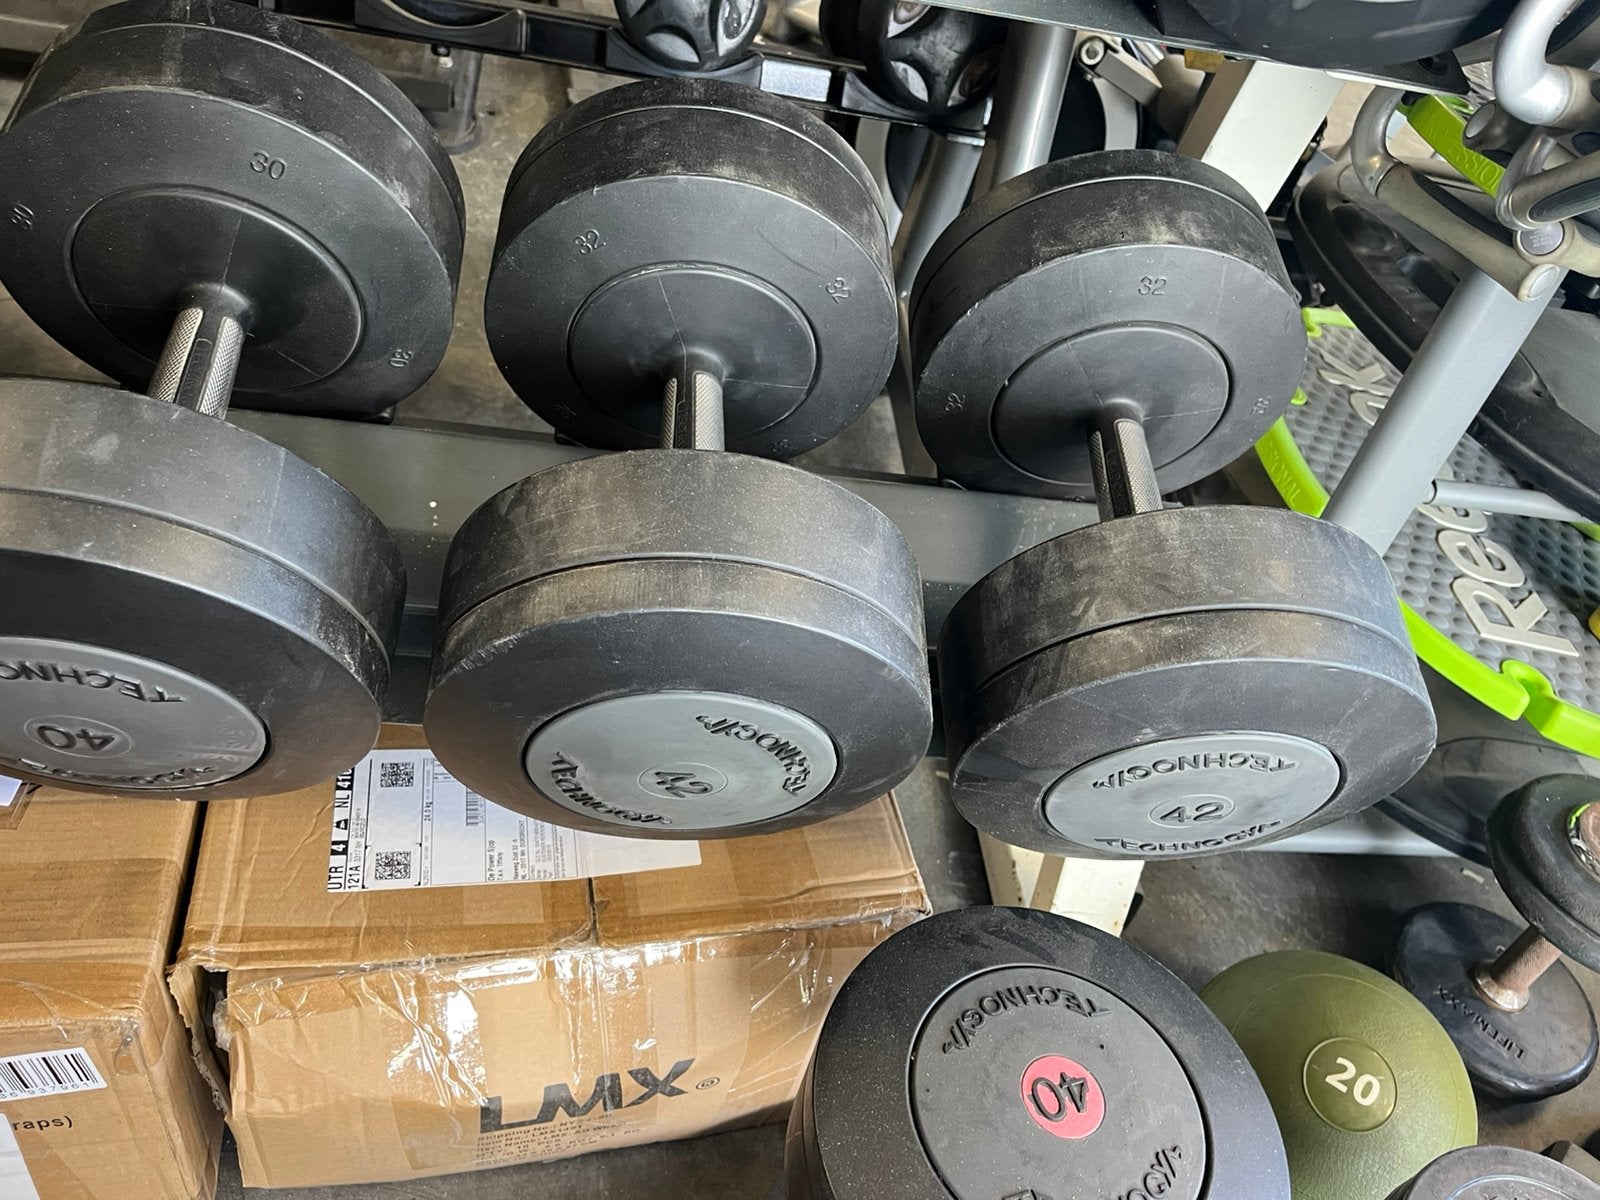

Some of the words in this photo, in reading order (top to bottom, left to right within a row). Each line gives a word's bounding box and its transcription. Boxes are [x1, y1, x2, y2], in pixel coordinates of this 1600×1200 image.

[249, 150, 286, 181] 30
[574, 229, 605, 256] 32
[826, 277, 851, 304] 32
[1138, 275, 1167, 296] 32
[37, 724, 115, 751] 40
[695, 714, 812, 796] TECHNOGYM
[654, 770, 713, 798] 42
[1092, 753, 1296, 789] TECHNOGYM
[550, 750, 672, 825] TECHNOGYM
[334, 795, 350, 808] NL
[1159, 802, 1225, 823] 42
[332, 844, 346, 852] 4
[1094, 820, 1281, 851] TECHNOGYM
[487, 854, 495, 872] Power
[327, 866, 344, 890] UTR
[347, 866, 361, 889] 121A
[487, 873, 495, 881] De
[942, 985, 1111, 1054] TECHNOGYM
[1433, 986, 1524, 1059] LIFEMAXX
[1325, 1057, 1380, 1106] 20
[480, 1058, 695, 1133] LMX
[1027, 1072, 1088, 1122] 40
